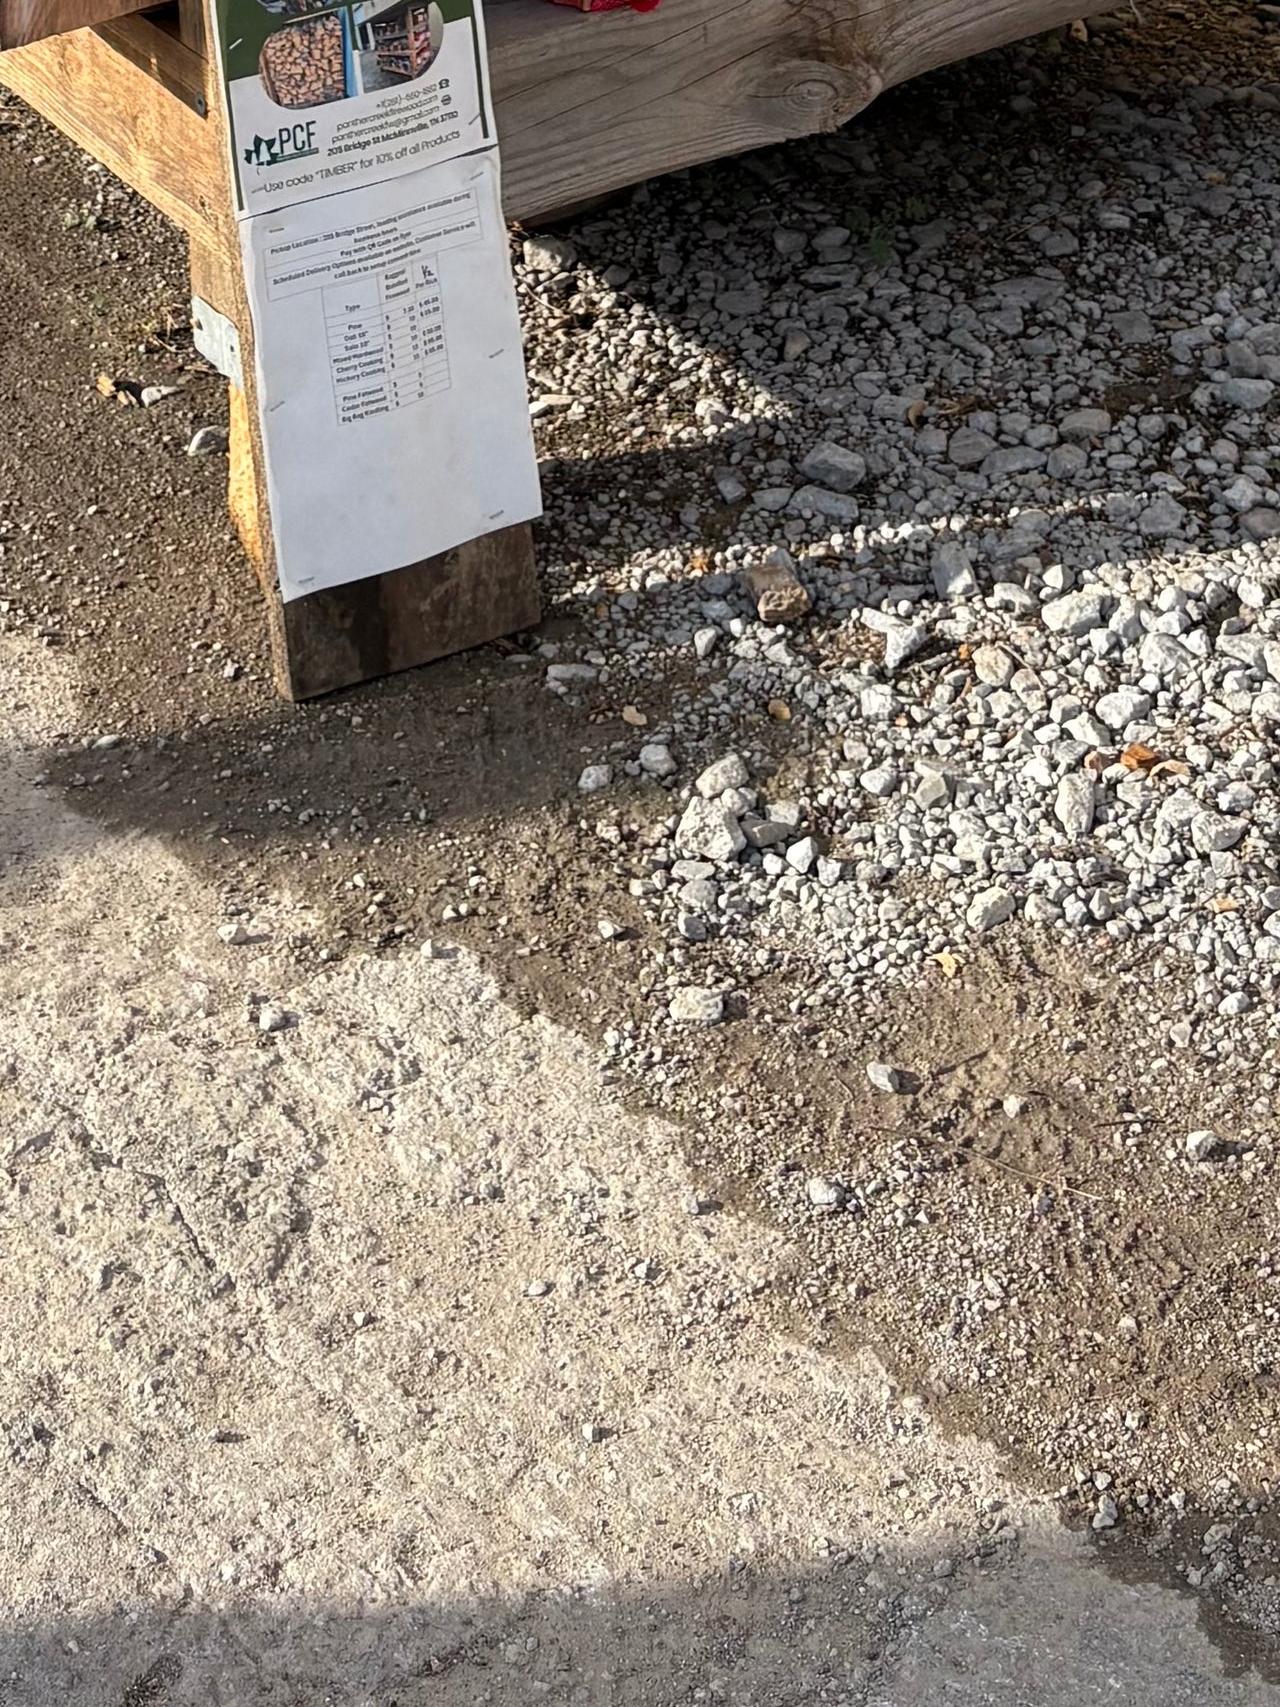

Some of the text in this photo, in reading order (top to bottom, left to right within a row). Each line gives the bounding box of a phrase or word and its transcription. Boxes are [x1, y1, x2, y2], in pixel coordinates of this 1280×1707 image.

[264, 181, 284, 193] Use
[285, 174, 314, 187] code
[360, 158, 373, 169] for
[376, 152, 394, 164] 10%
[395, 146, 407, 160] off
[409, 143, 420, 155] all
[421, 130, 460, 151] Products
[278, 120, 317, 155] PCF
